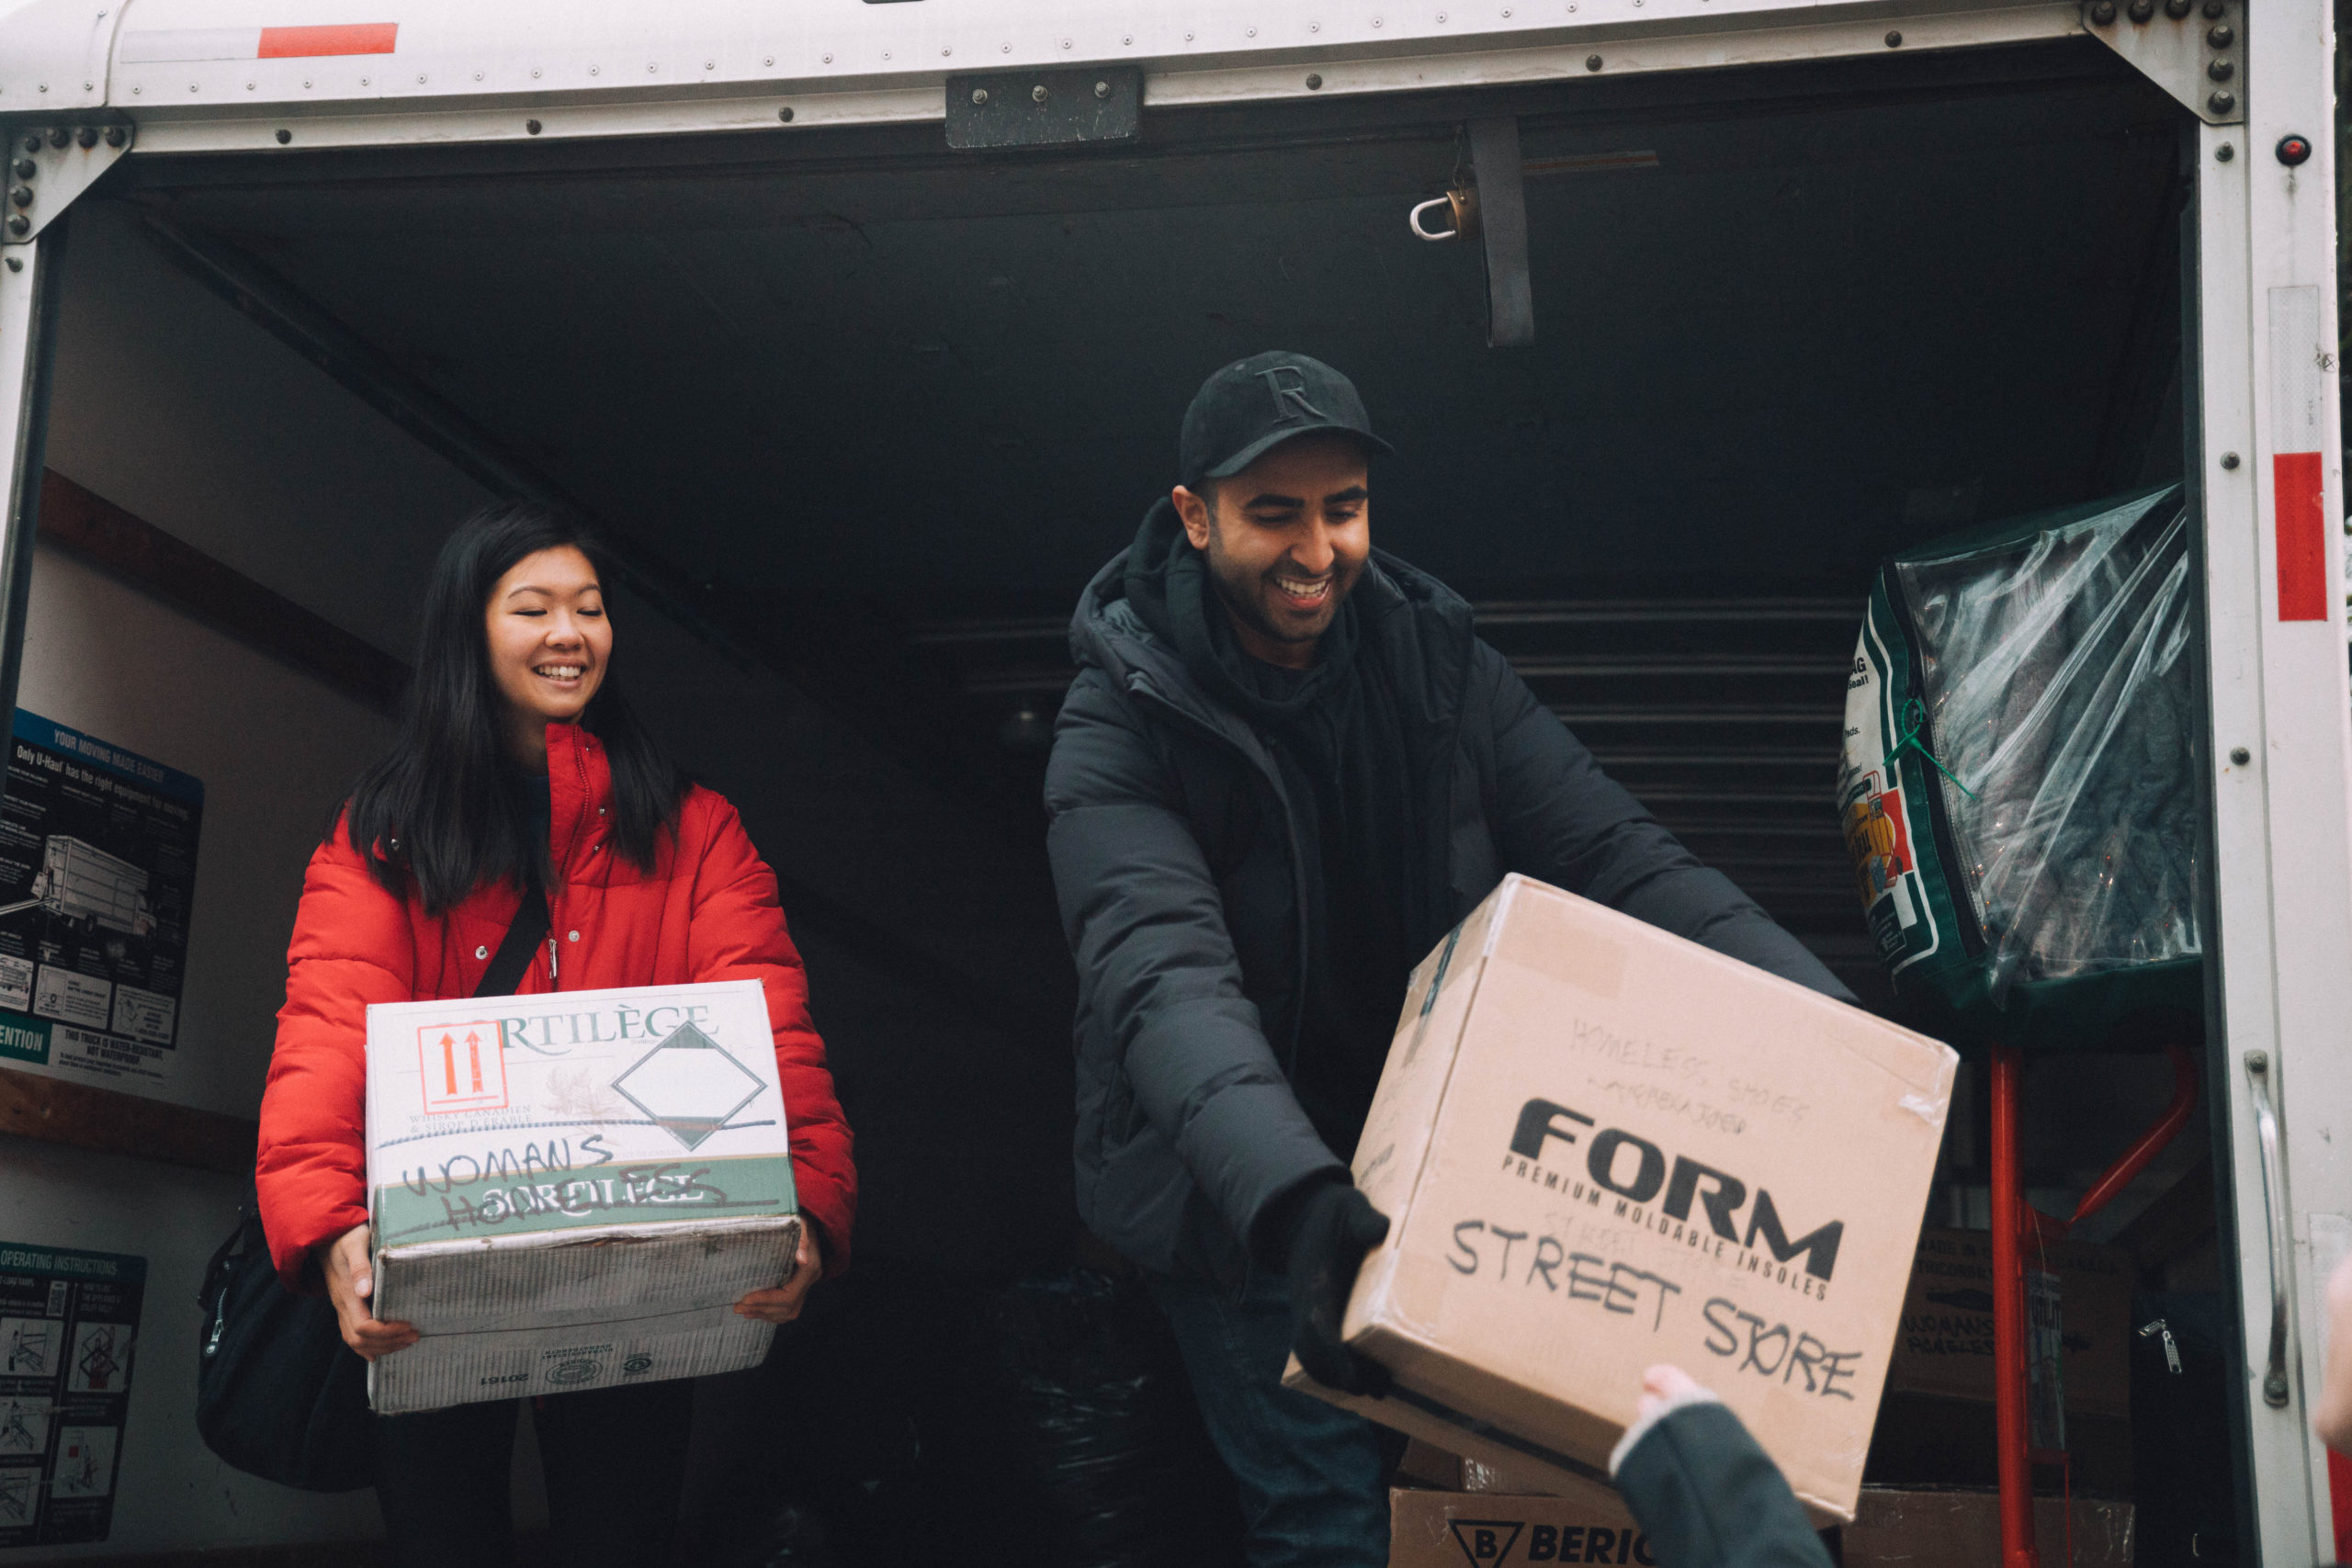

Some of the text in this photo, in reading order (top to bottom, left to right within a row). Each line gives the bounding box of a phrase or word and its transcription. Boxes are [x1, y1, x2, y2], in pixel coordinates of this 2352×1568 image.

[1254, 366, 1328, 424] R
[17, 745, 35, 765] Only
[65, 761, 80, 779] has
[81, 768, 93, 784] the
[95, 774, 113, 793] right
[54, 728, 76, 750] YOUR
[78, 739, 111, 762] MOVING
[112, 750, 136, 772] MADE
[65, 1030, 79, 1042] THIS
[81, 1032, 100, 1046] TRUCK
[102, 1037, 108, 1048] IS
[86, 1045, 99, 1055] NOT
[500, 1003, 720, 1056] RTILÈGE
[410, 1125, 420, 1134] &
[1510, 1097, 1844, 1282] FORM
[1503, 1156, 1827, 1302] PREMIUM MOLDABLE INSOLES
[0, 1249, 118, 1276] OPERATING INSTRUCTIONS
[1446, 1220, 1863, 1402] STREET STORE
[480, 1372, 529, 1386] 20161
[1475, 1529, 1498, 1559] B
